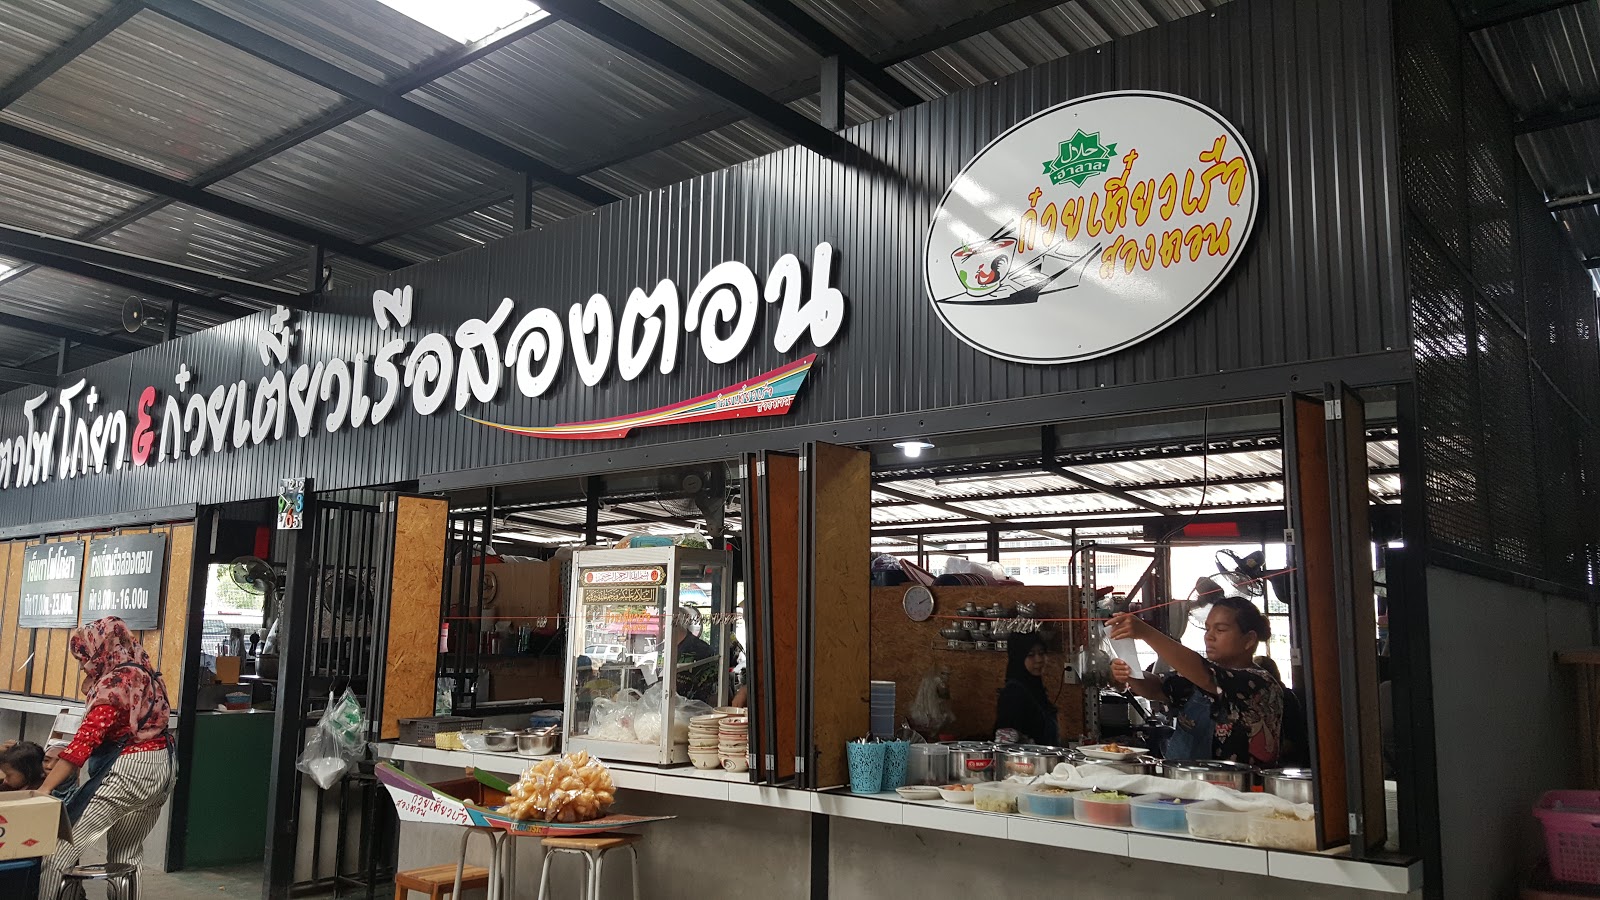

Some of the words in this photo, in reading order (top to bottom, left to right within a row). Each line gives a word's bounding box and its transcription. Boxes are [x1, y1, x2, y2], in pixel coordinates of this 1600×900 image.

[1060, 142, 1099, 164] حلال
[1057, 161, 1103, 180] ฮาลาล
[1017, 134, 1248, 254] ก๋วยเตี๋ยวเรือ
[1099, 217, 1232, 279] สองตอน
[132, 386, 156, 466] &
[296, 494, 303, 513] 3
[286, 508, 294, 528] 6
